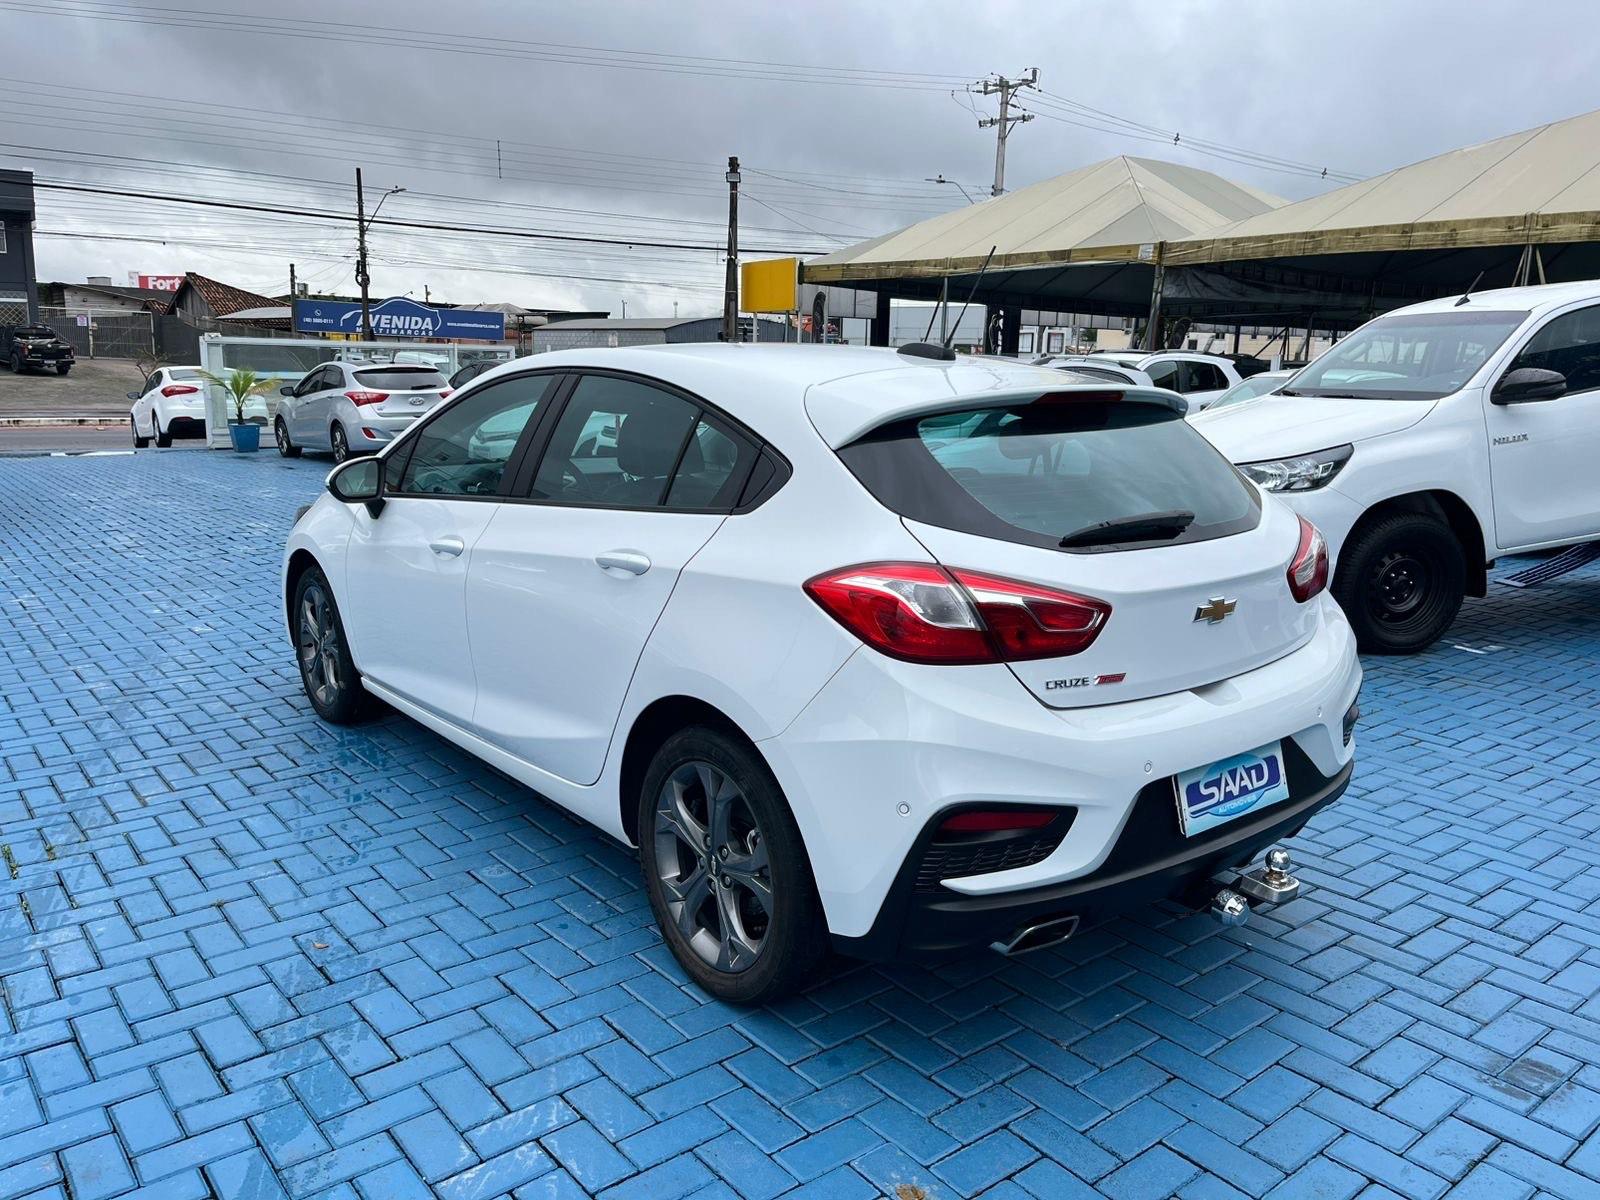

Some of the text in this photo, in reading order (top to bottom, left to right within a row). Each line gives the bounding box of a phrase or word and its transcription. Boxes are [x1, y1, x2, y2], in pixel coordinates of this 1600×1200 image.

[356, 326, 433, 337] MLTIMARCAS
[1046, 676, 1090, 691] CRUZE
[1198, 757, 1269, 802] SAAD
